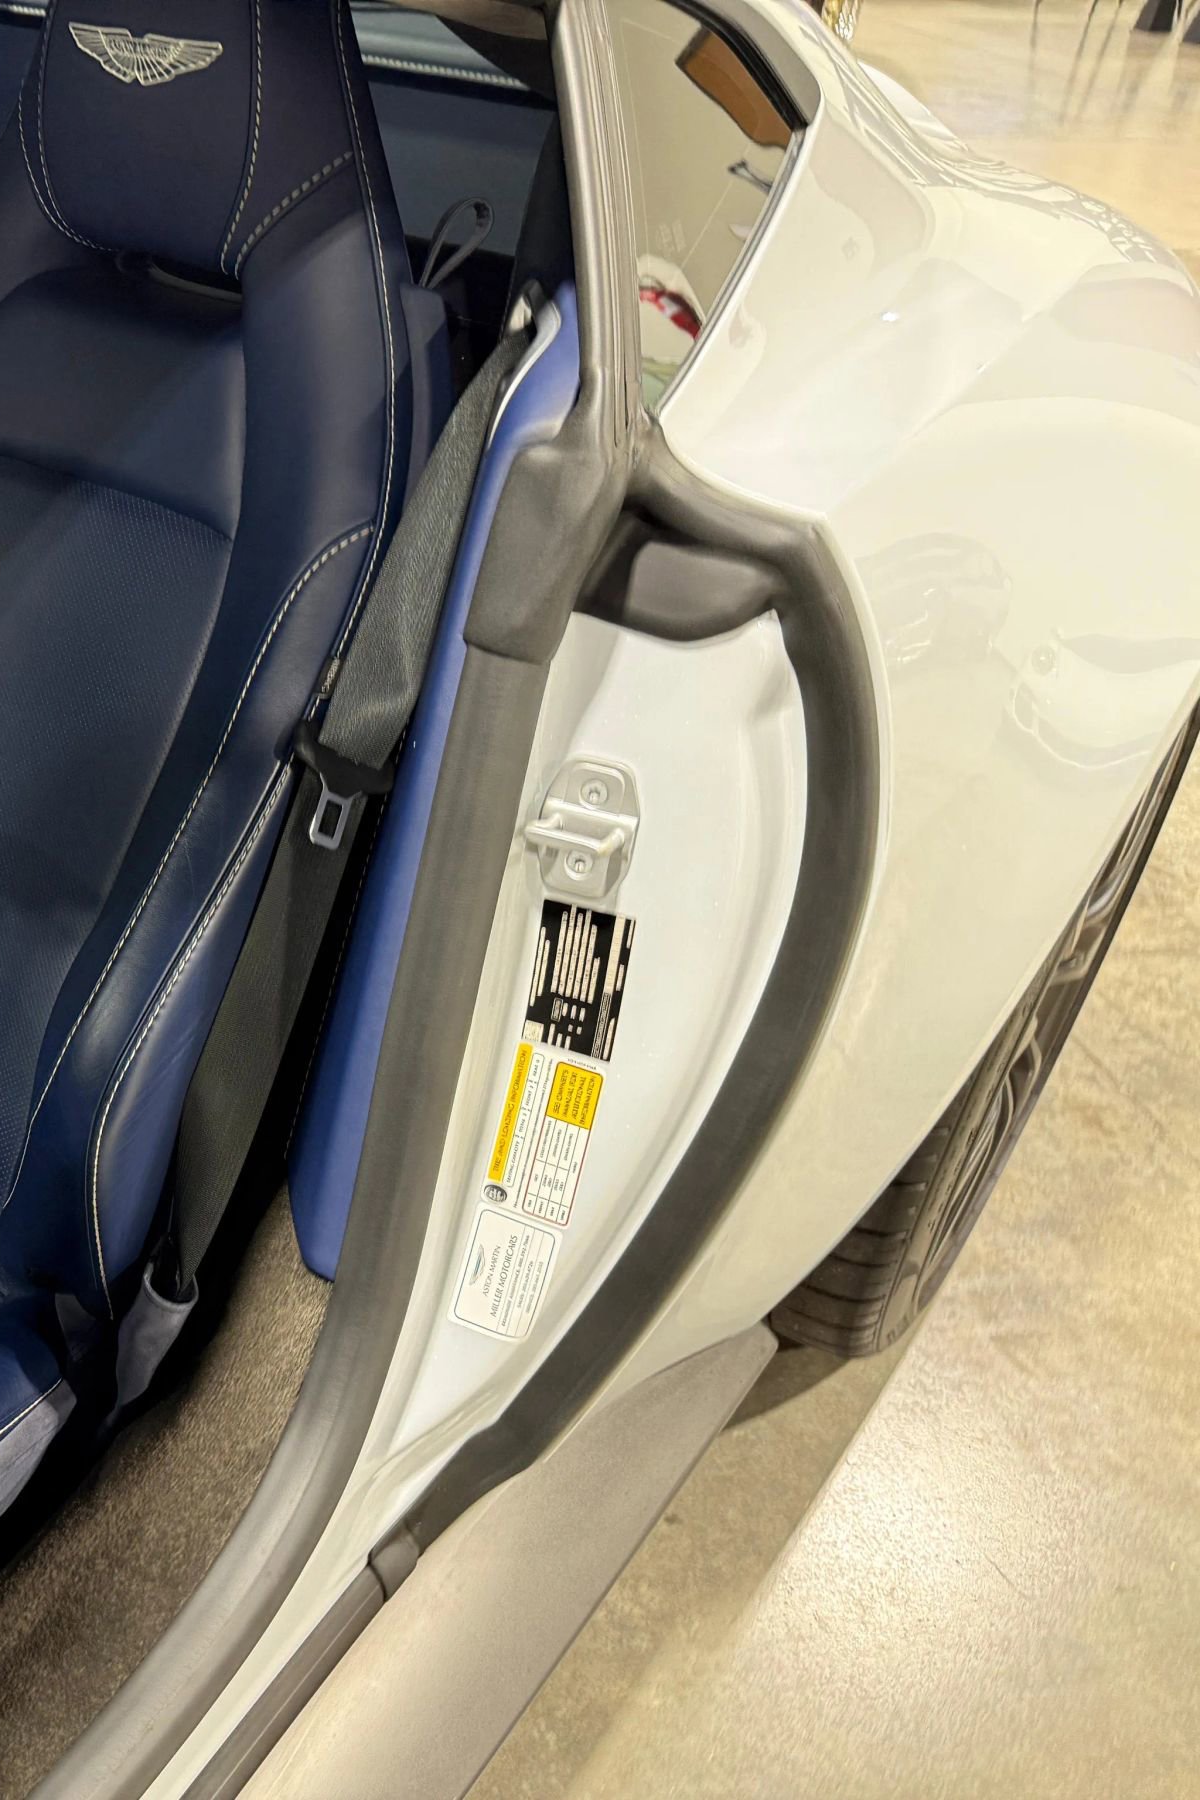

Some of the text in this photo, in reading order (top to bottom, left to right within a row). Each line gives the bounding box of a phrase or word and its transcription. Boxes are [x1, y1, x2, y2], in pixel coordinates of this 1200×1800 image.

[496, 1138, 505, 1156] AND
[501, 1102, 514, 1137] LOADING
[510, 1049, 527, 1102] INFORMATION
[482, 1244, 501, 1296] ASTON MARTIN
[489, 1234, 518, 1317] MILLER MOTORCARS
